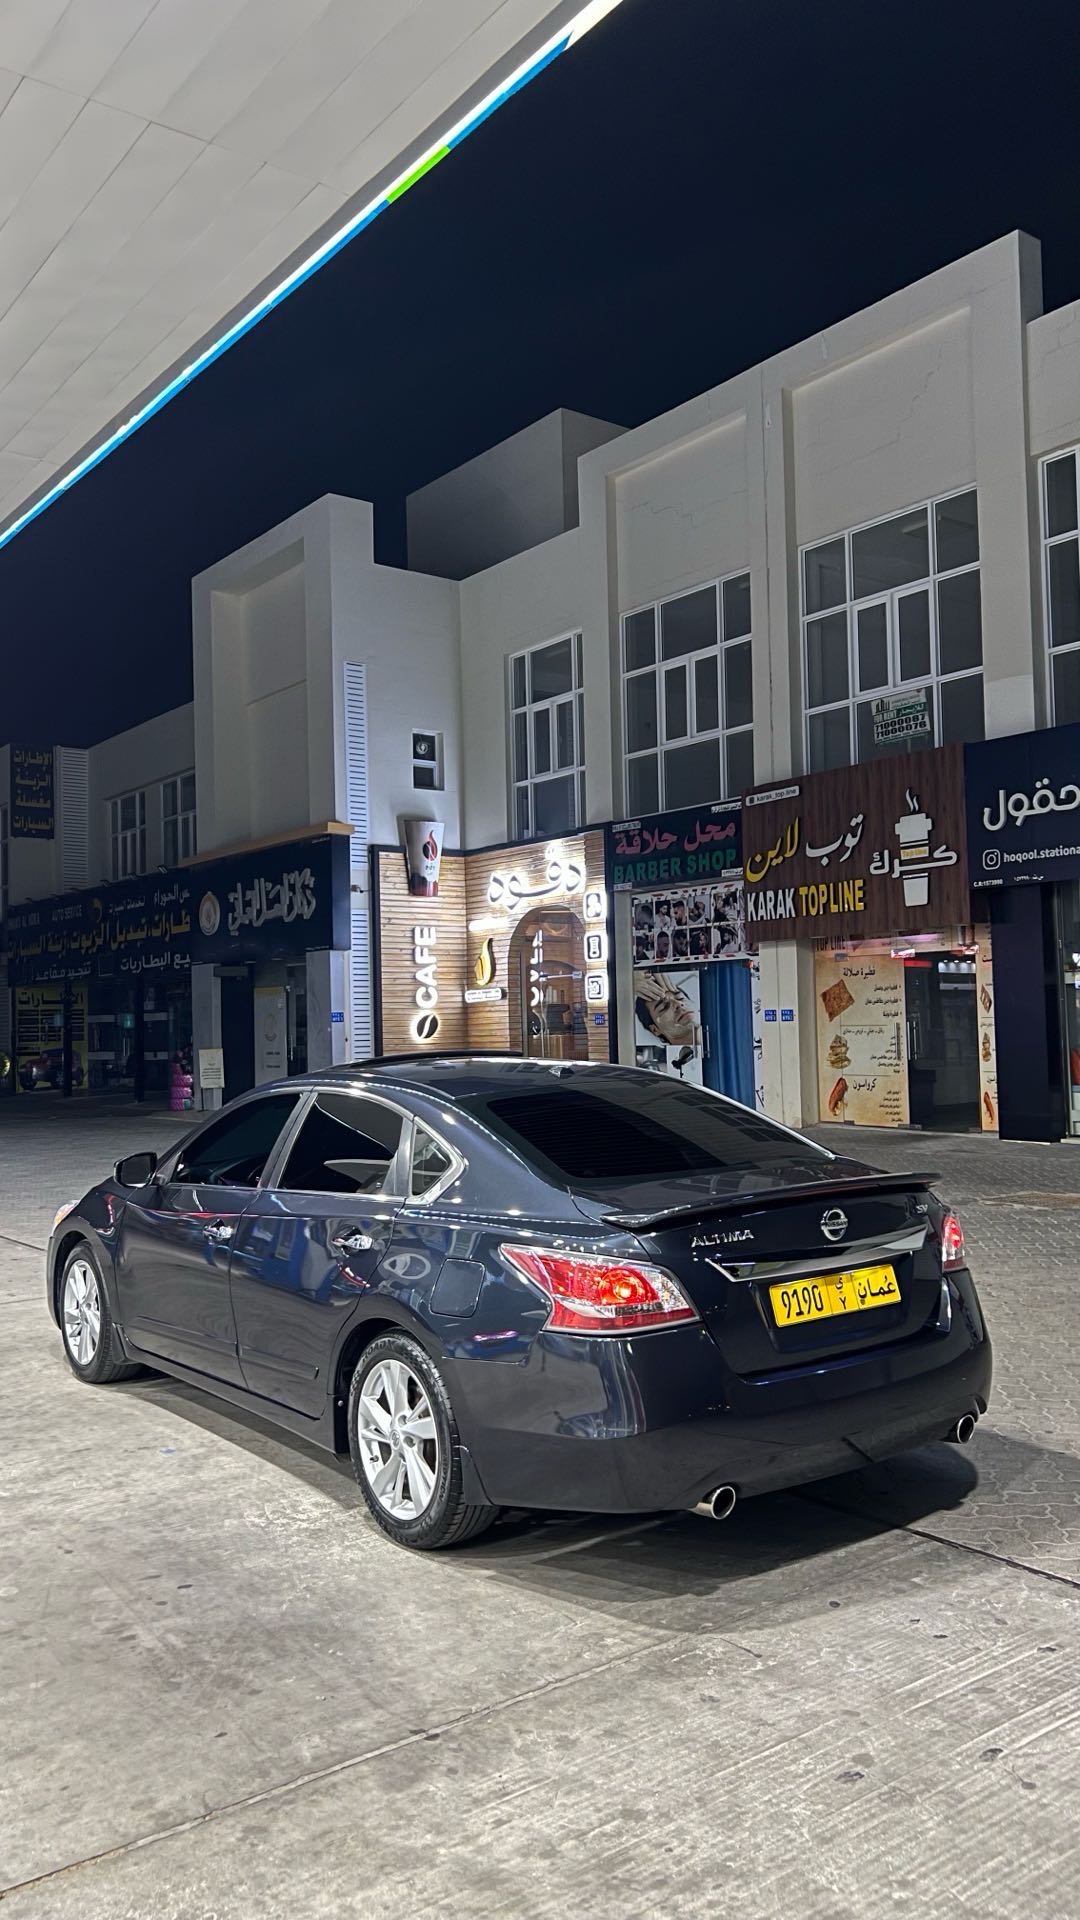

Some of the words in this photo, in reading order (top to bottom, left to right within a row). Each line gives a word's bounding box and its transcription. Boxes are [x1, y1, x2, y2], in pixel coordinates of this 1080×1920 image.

[614, 828, 678, 855] حلاقة
[684, 820, 736, 852] محل
[746, 816, 799, 883] لاين
[805, 814, 864, 867] توب
[614, 857, 681, 883] BARBER
[687, 849, 736, 874] SHOP
[747, 888, 797, 922] KARAK
[120, 951, 170, 974] البطاريات
[414, 926, 438, 1009] CAFE
[853, 1078, 877, 1092] كرواسون
[915, 1204, 928, 1213] SV
[691, 1229, 754, 1248] ALTIMA
[781, 1284, 824, 1319] 9190
[839, 1296, 847, 1310] Y
